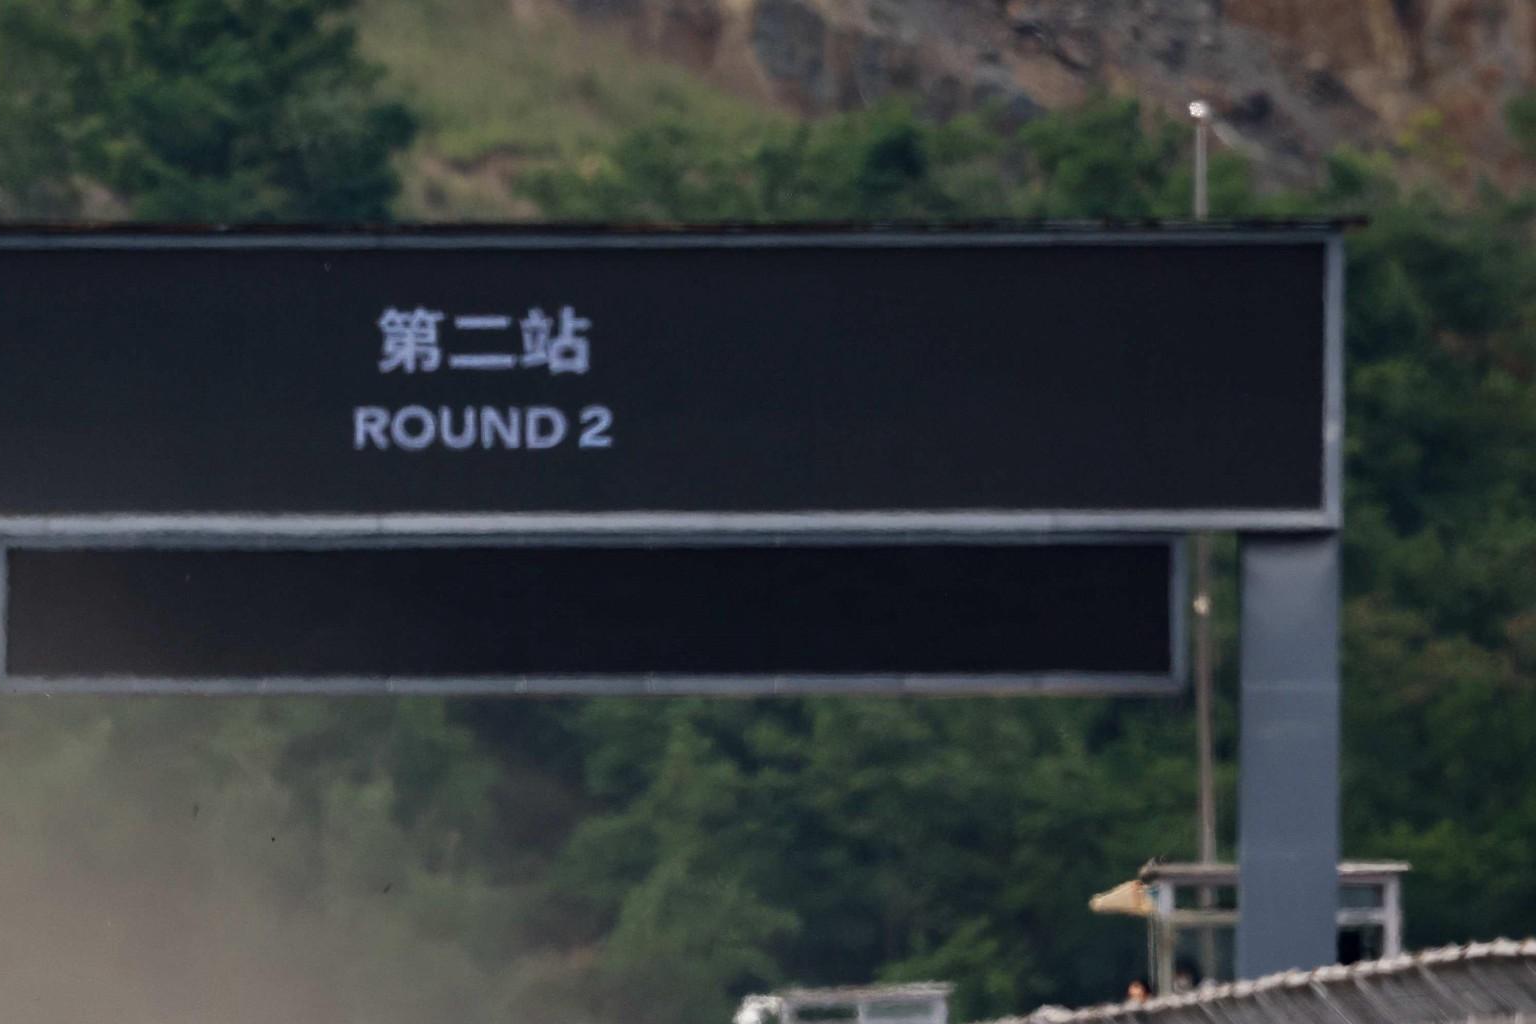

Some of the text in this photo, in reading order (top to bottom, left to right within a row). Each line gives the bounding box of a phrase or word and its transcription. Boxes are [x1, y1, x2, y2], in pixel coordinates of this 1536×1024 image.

[378, 306, 591, 374] 第二站
[353, 405, 613, 450] ROUND 2
